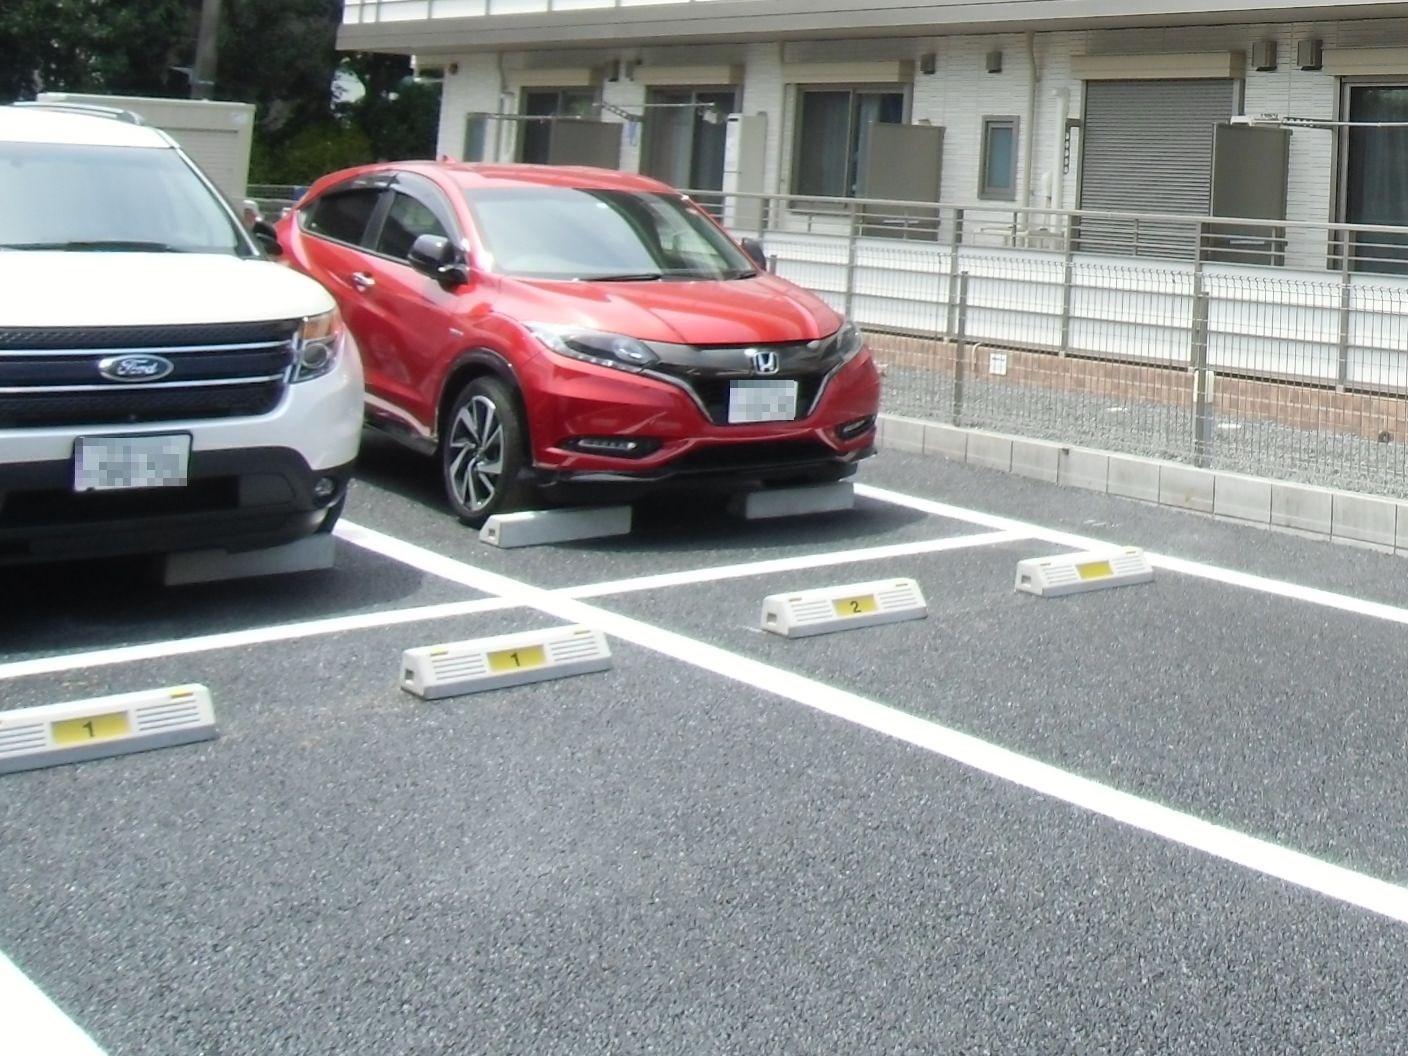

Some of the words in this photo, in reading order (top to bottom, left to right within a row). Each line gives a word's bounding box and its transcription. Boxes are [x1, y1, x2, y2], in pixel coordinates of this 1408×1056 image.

[117, 359, 158, 375] Ford
[849, 600, 862, 613] 2
[510, 652, 520, 667] 1
[82, 720, 94, 737] 1
